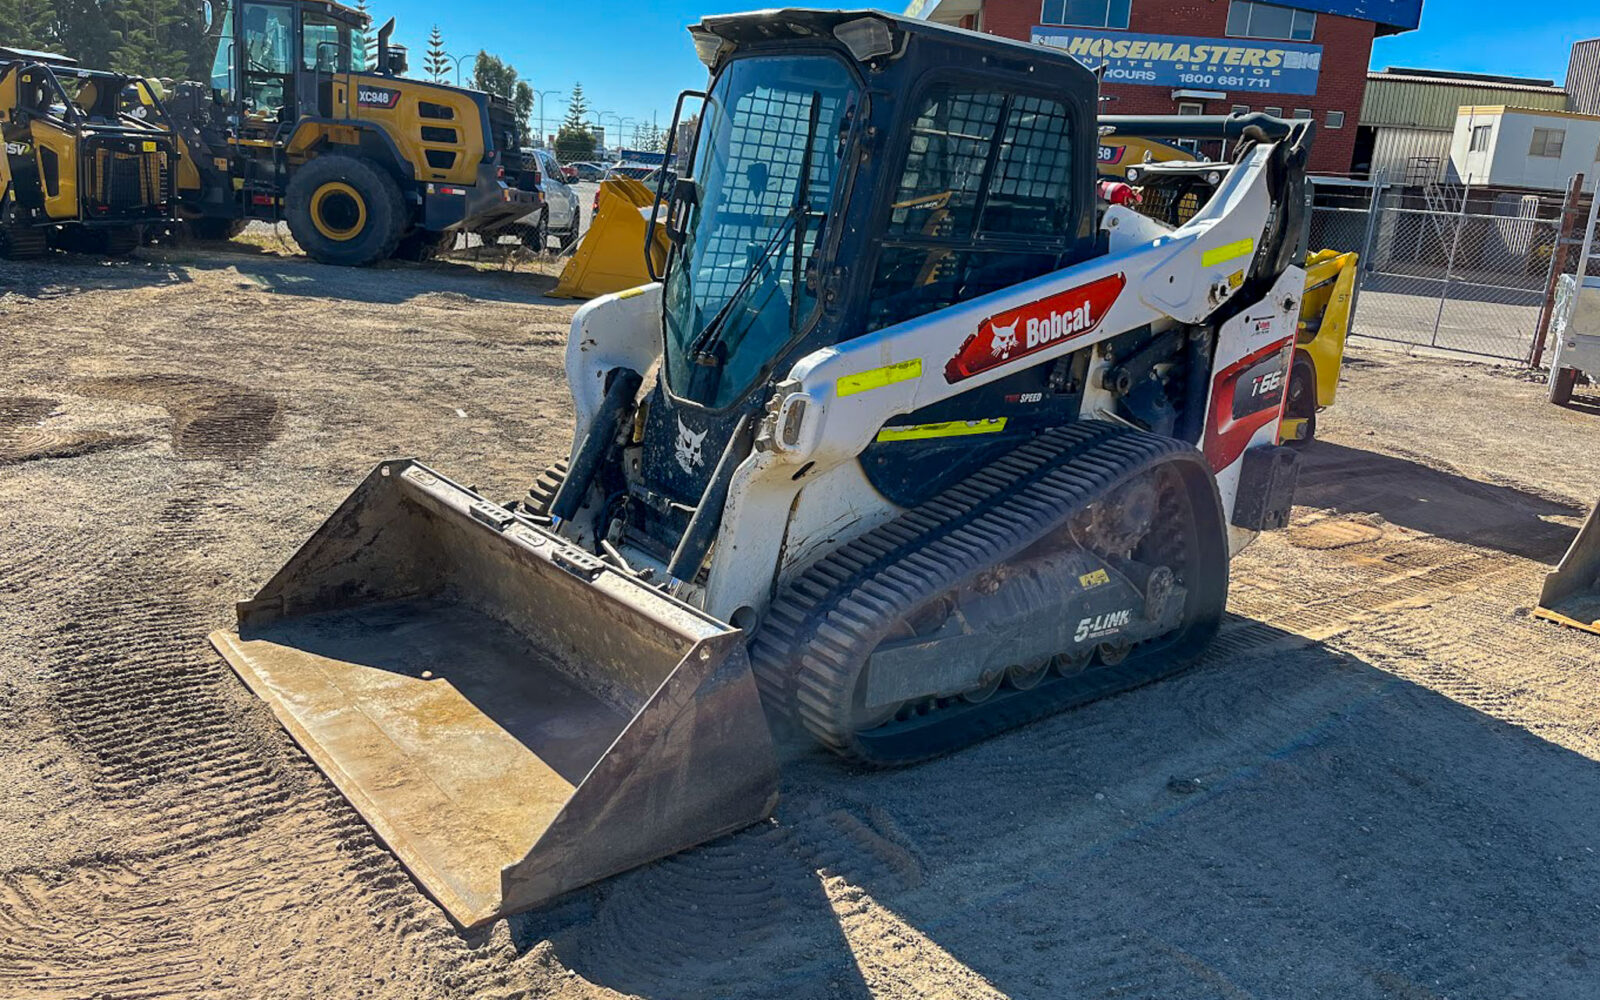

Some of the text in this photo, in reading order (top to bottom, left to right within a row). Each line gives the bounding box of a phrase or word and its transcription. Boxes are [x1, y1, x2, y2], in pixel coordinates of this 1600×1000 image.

[1069, 37, 1285, 67] HOSEMASTERS
[1083, 58, 1281, 76] NSITE SERVICE
[1103, 69, 1271, 88] HOURS 1800 681 711
[359, 90, 389, 104] XC948
[4, 142, 26, 156] SV
[1026, 300, 1091, 349] Bobcat
[1251, 370, 1282, 397] T66
[1020, 392, 1042, 403] SPEED
[1074, 610, 1129, 642] 5-LINK
